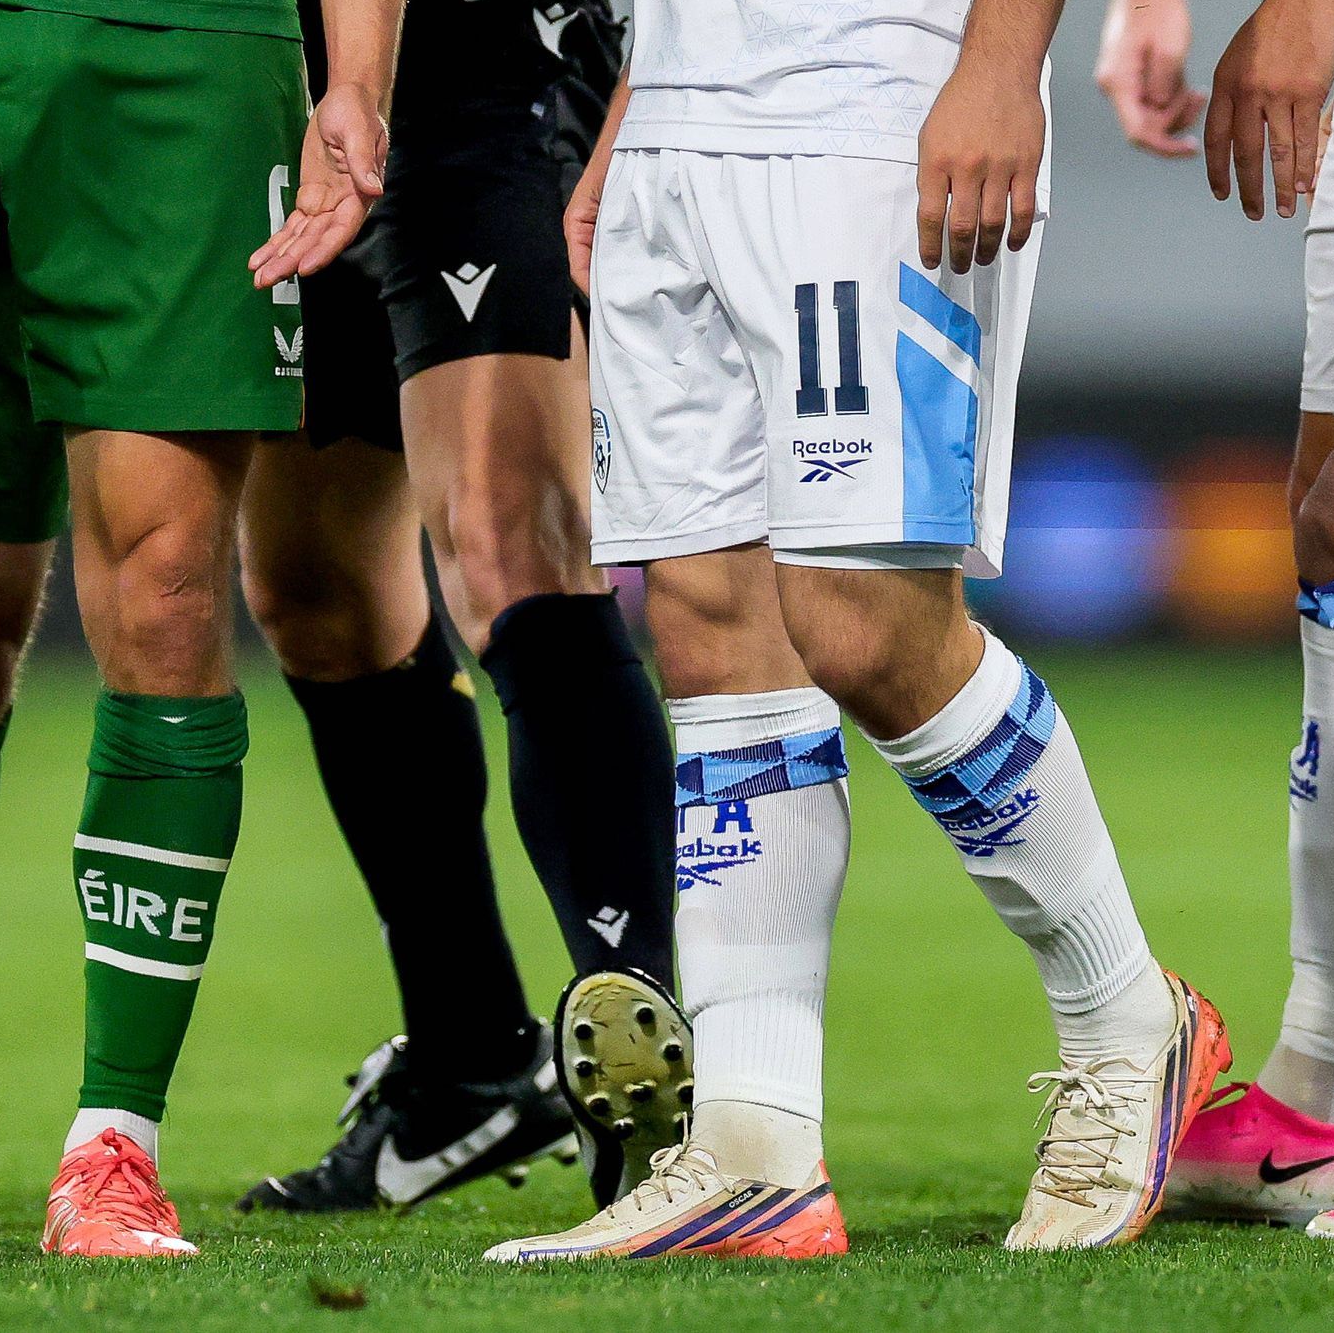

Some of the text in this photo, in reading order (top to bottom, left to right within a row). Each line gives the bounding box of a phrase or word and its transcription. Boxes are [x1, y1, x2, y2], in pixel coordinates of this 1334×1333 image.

[794, 280, 870, 418] 11
[793, 439, 873, 458] Reebok
[78, 868, 209, 943] ÉIRE
[728, 1190, 754, 1209] OSCAR
